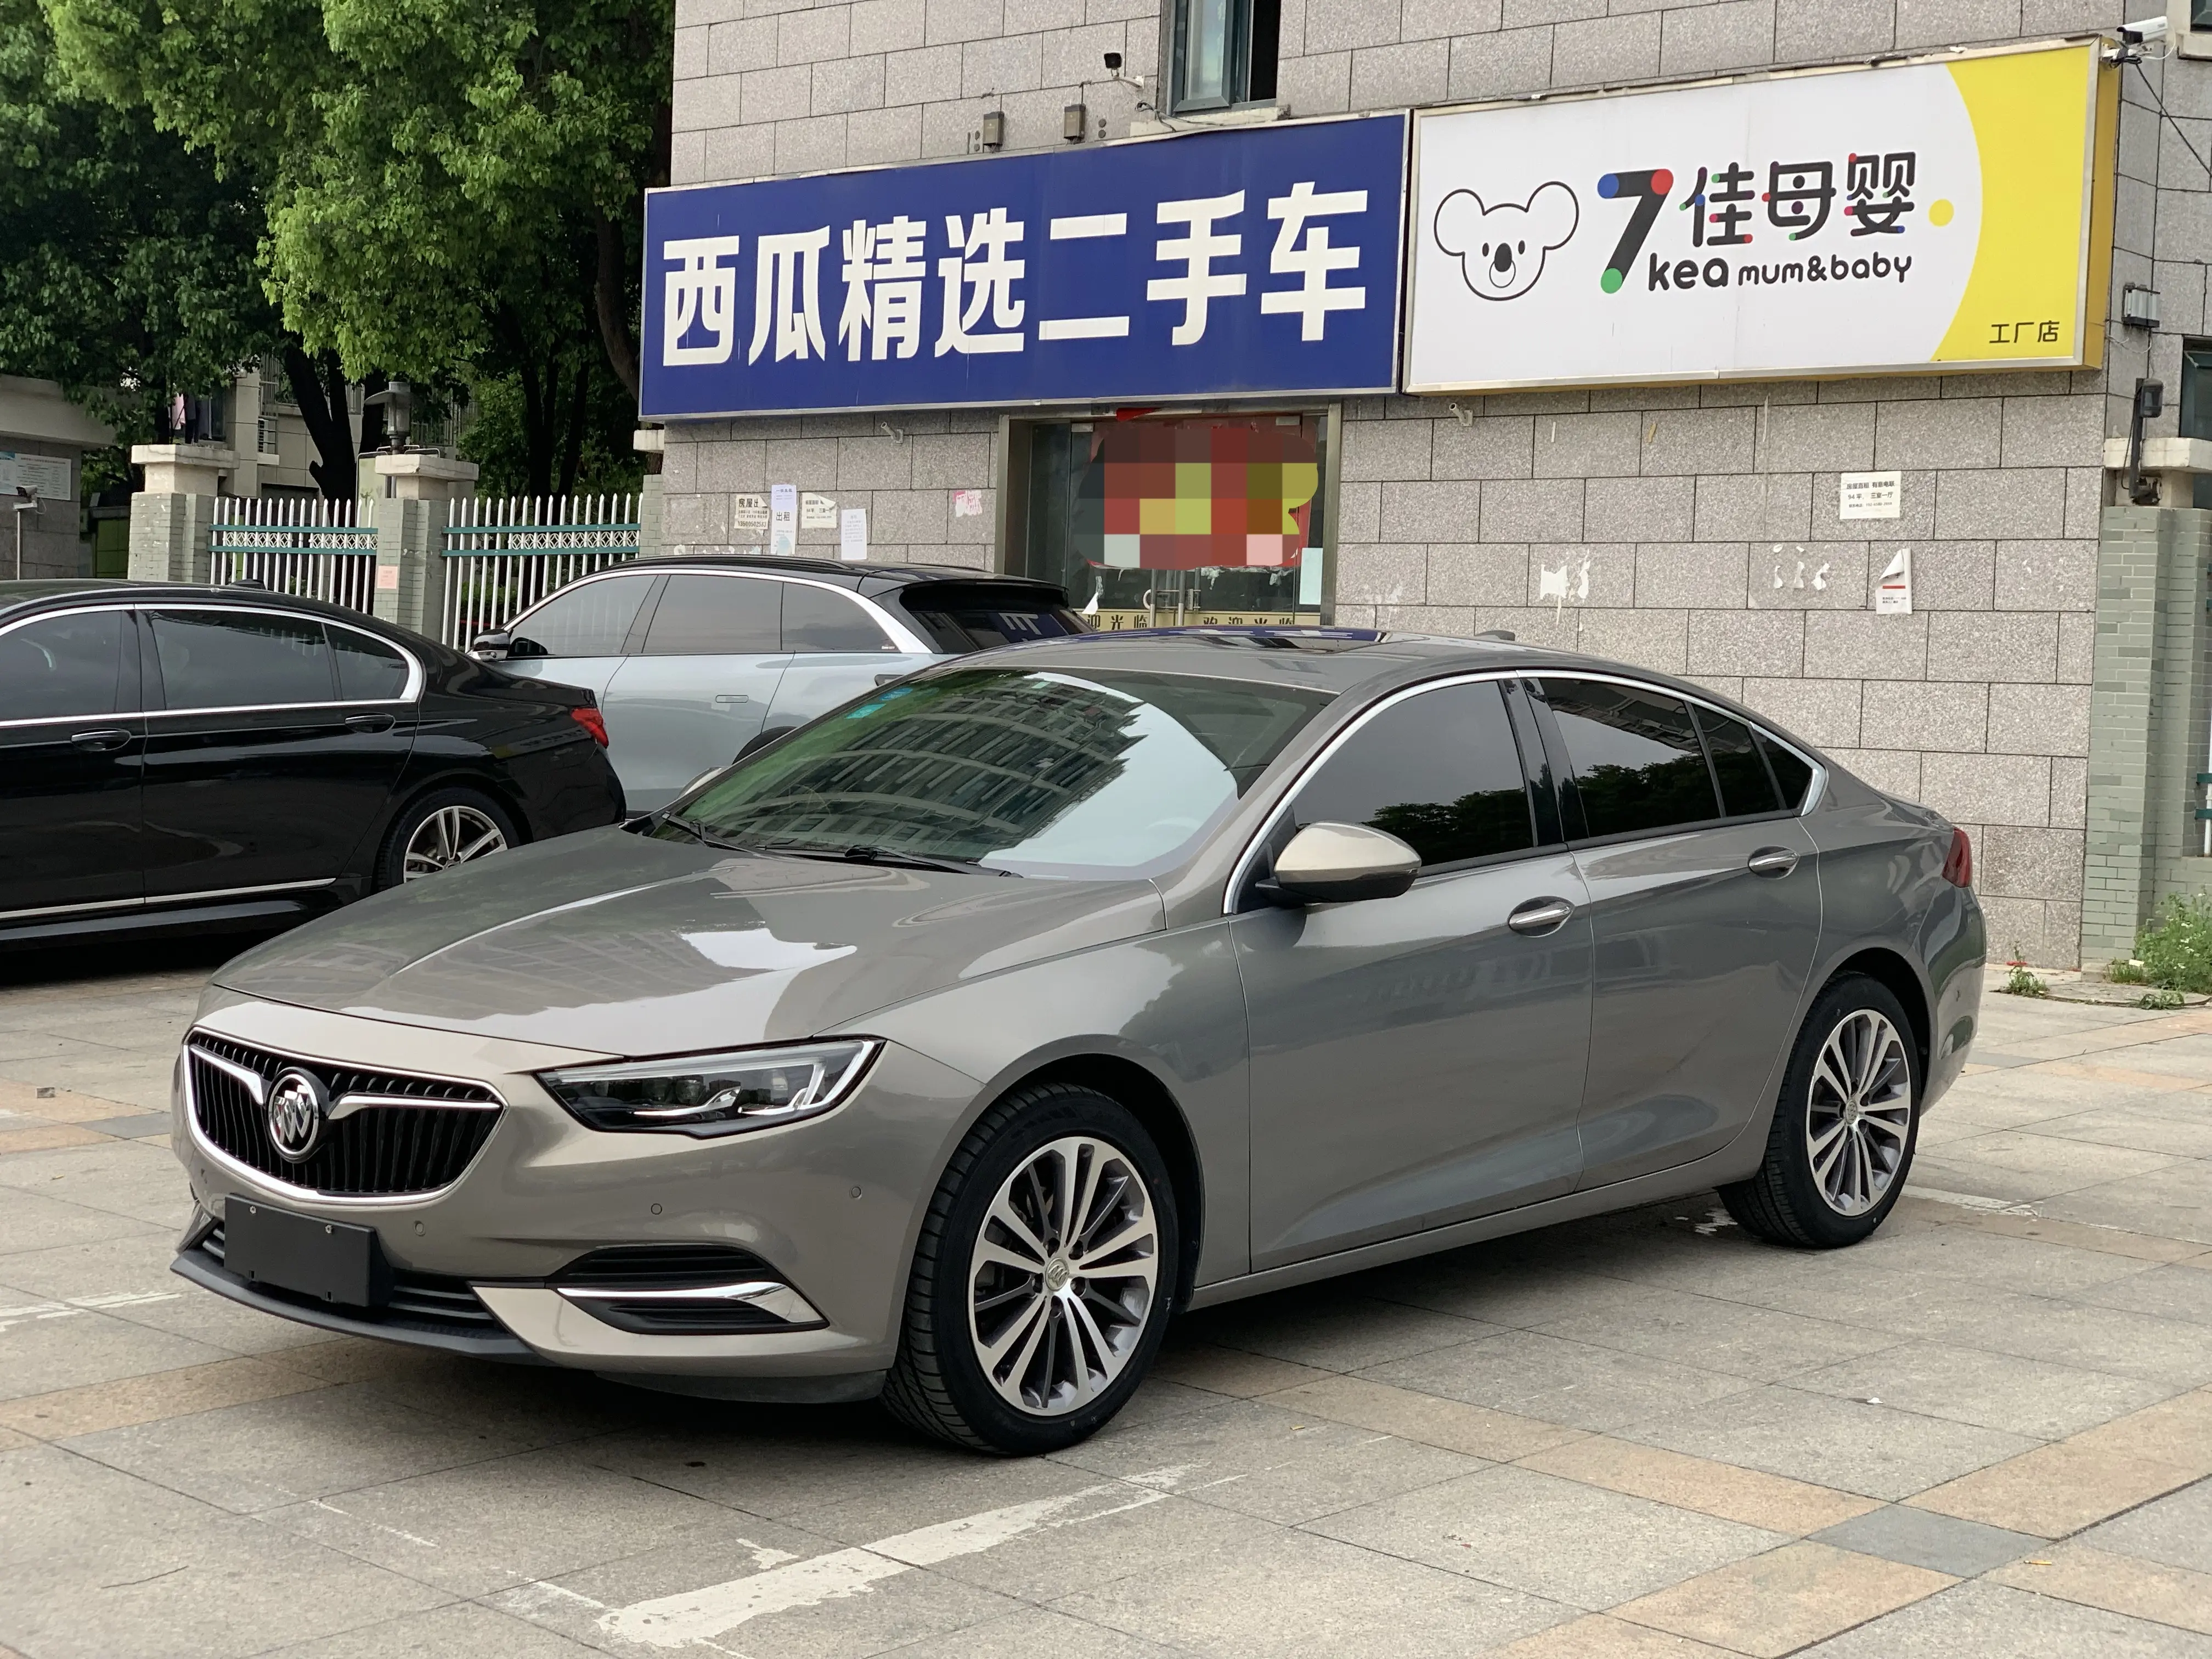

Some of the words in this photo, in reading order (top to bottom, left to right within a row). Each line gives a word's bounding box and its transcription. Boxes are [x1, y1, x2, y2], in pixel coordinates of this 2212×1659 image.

[663, 181, 1368, 366] 西瓜精选二手车
[1648, 252, 1729, 291] kea
[1738, 251, 1912, 286] mum&baby
[1989, 320, 2060, 343] 工厂店
[738, 498, 768, 507] 房屋出
[776, 511, 791, 521] 出租
